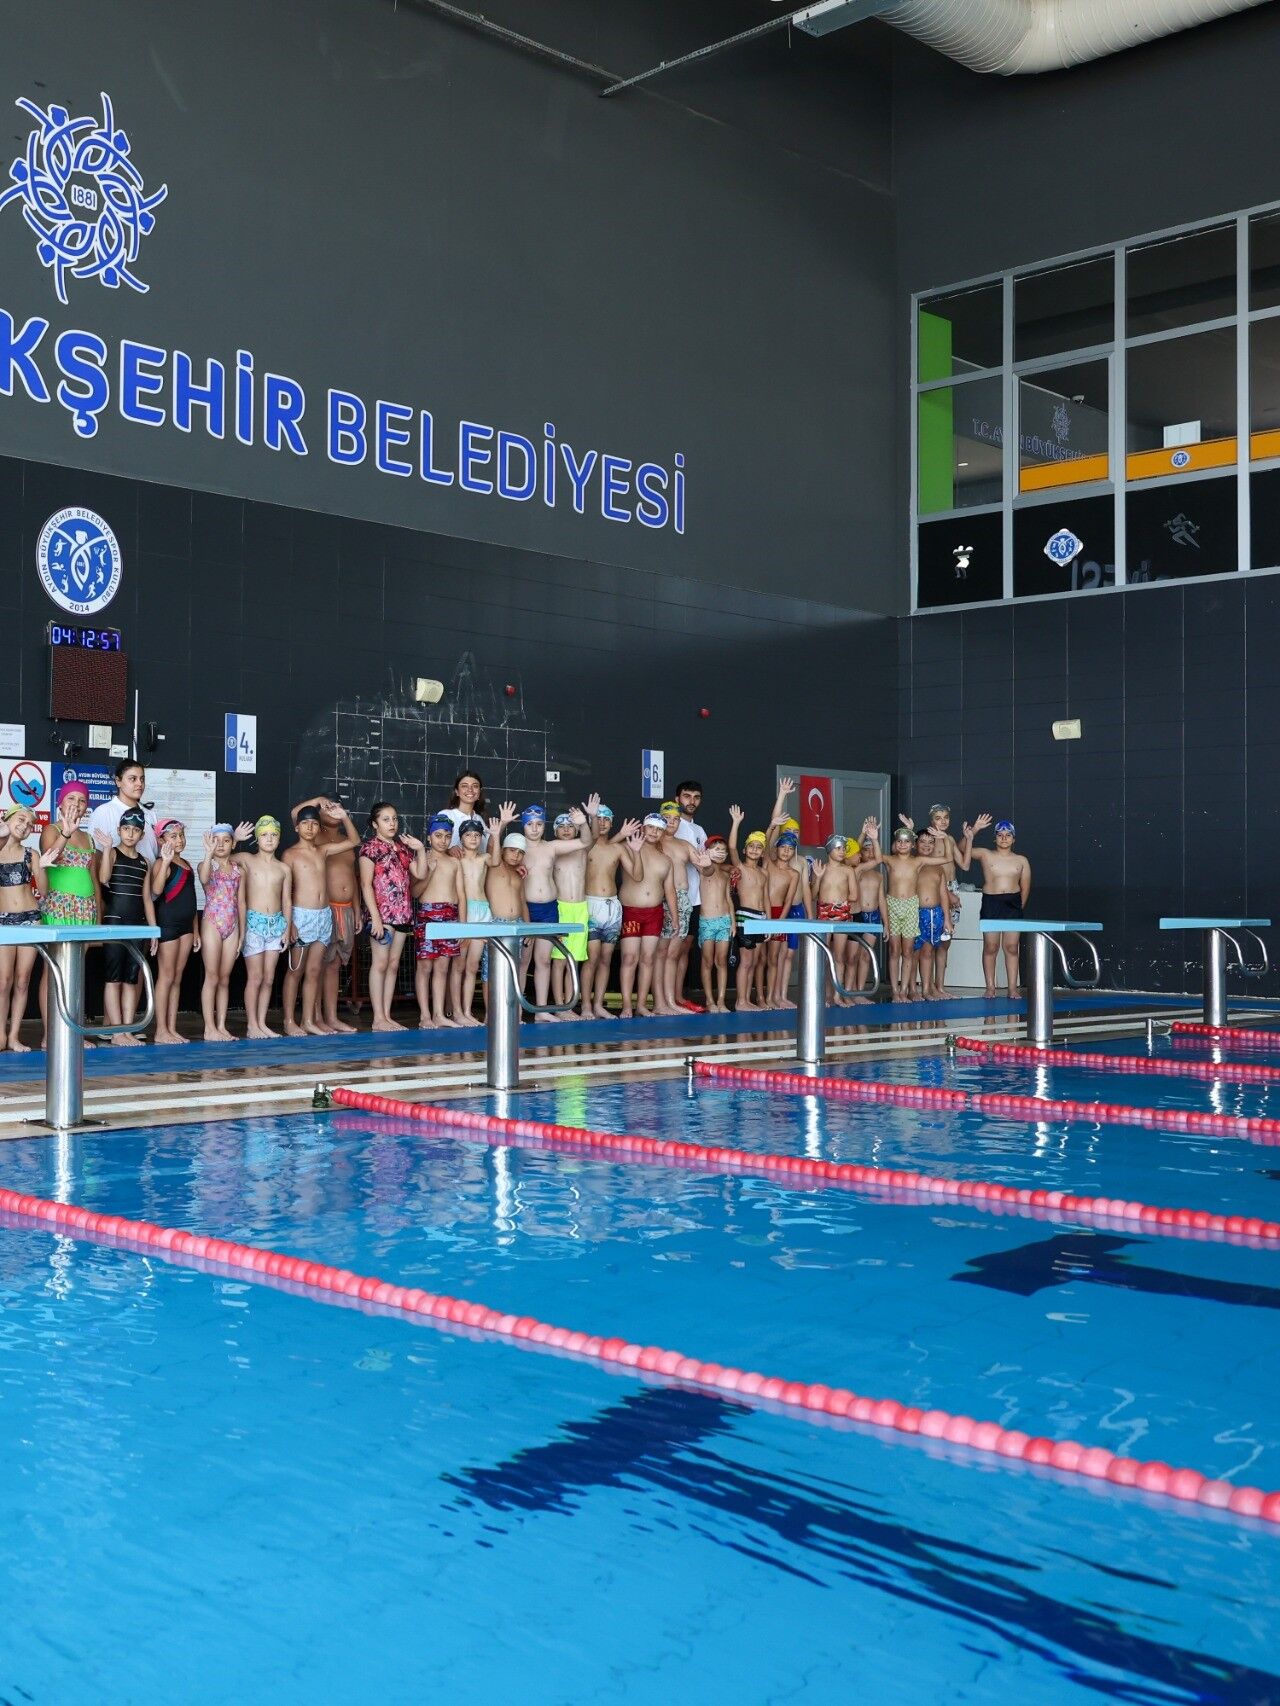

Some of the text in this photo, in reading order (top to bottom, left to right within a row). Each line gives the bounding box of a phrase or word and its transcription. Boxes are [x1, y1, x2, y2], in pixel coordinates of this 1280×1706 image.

[71, 185, 97, 210] 1881
[327, 389, 685, 534] BELEDİYESİ
[69, 602, 90, 612] 2014
[239, 731, 254, 755] 4.
[652, 764, 662, 783] 6.
